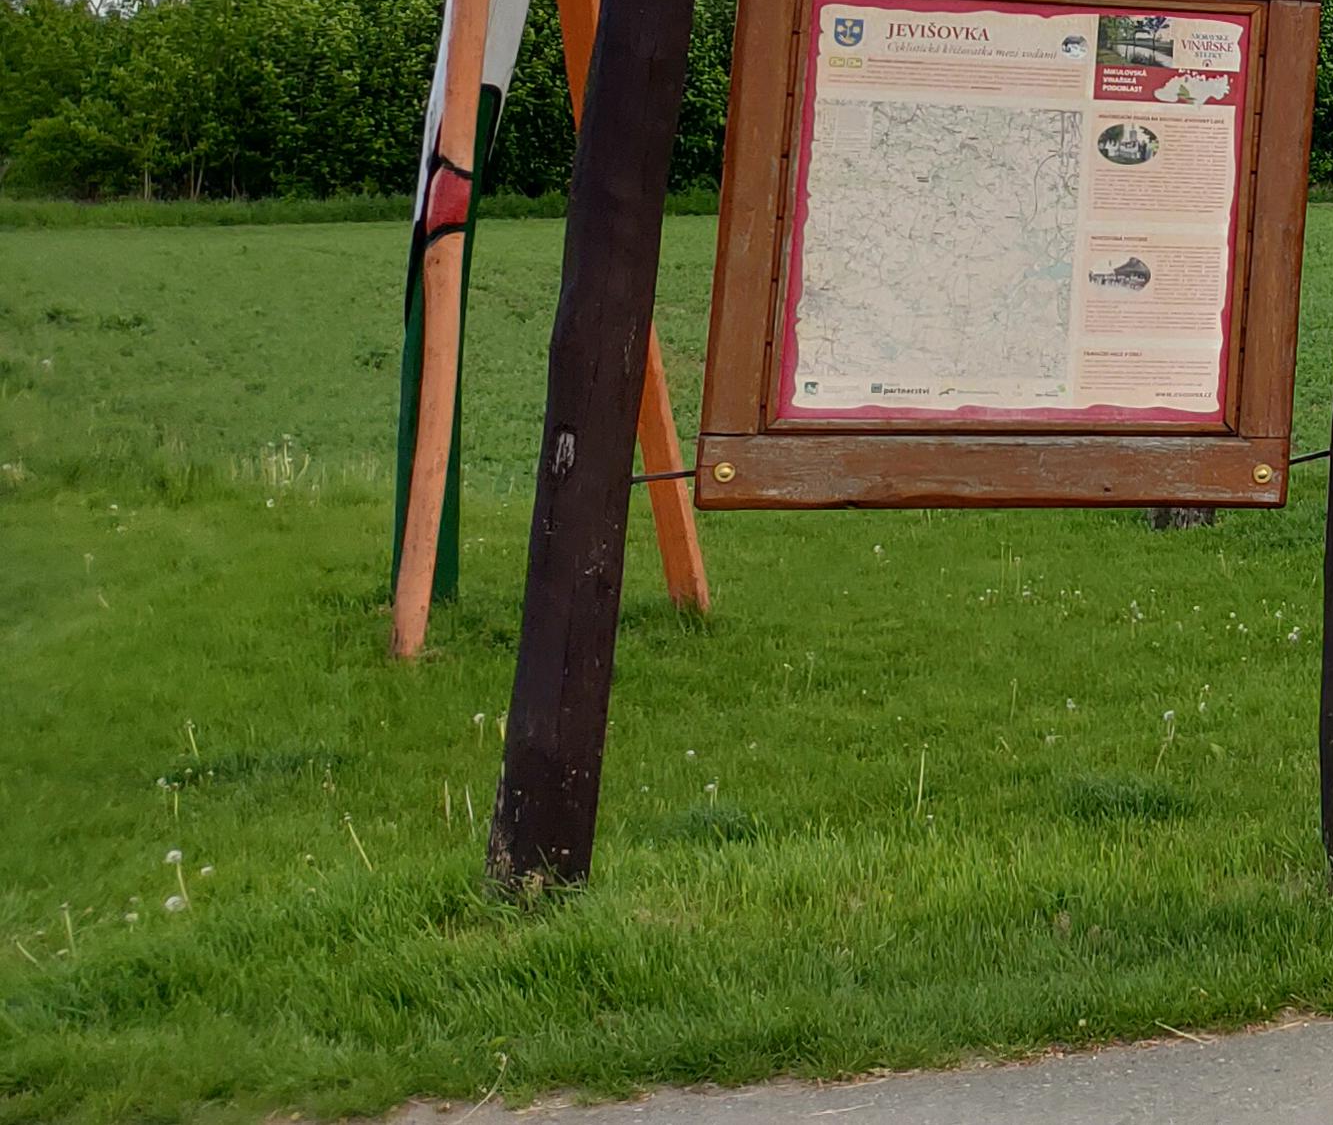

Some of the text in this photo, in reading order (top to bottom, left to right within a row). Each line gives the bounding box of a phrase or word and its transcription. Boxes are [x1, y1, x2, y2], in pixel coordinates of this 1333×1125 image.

[886, 22, 989, 41] JEVIŠOVKA
[996, 47, 1018, 58] mezi
[1022, 49, 1057, 60] vodami
